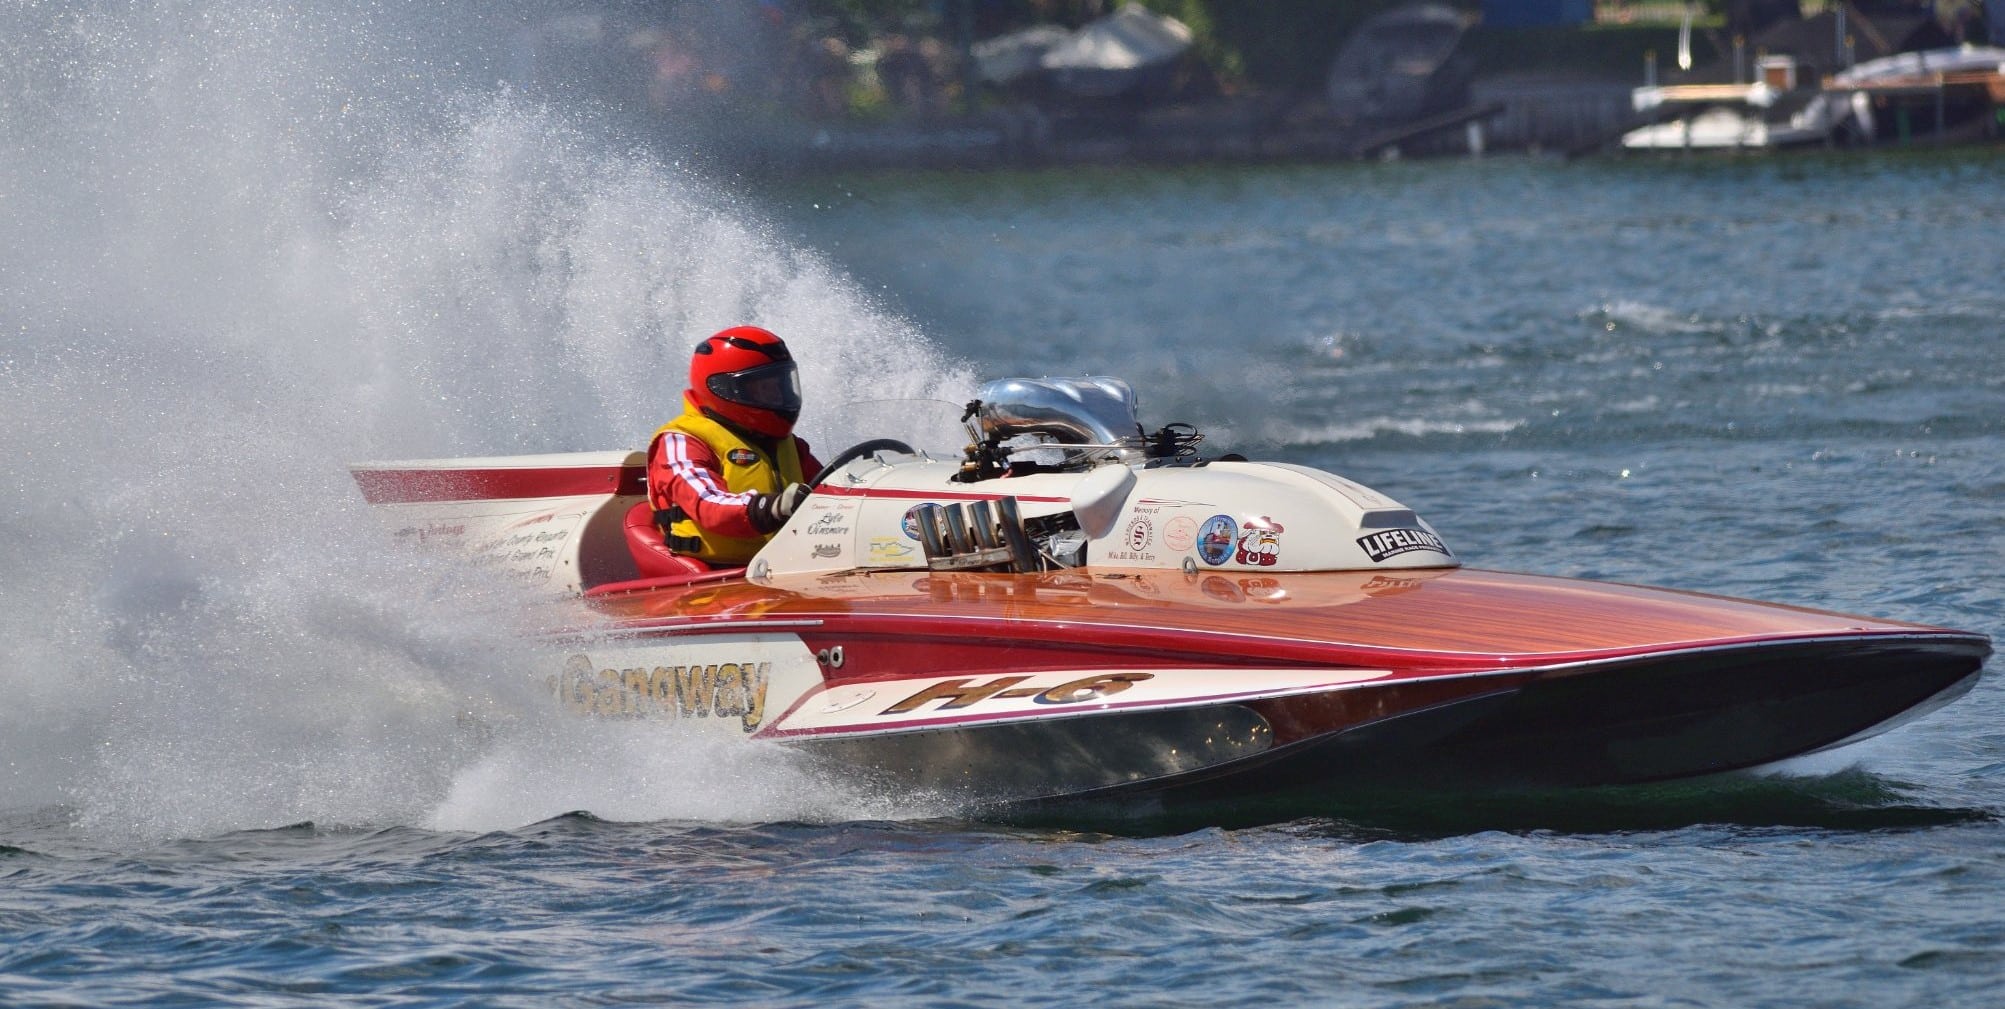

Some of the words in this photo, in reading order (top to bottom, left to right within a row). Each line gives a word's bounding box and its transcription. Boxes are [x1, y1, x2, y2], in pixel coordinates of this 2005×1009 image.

[1362, 530, 1443, 557] LIFELINE
[560, 654, 771, 734] Gangway
[878, 673, 1155, 716] H-6
